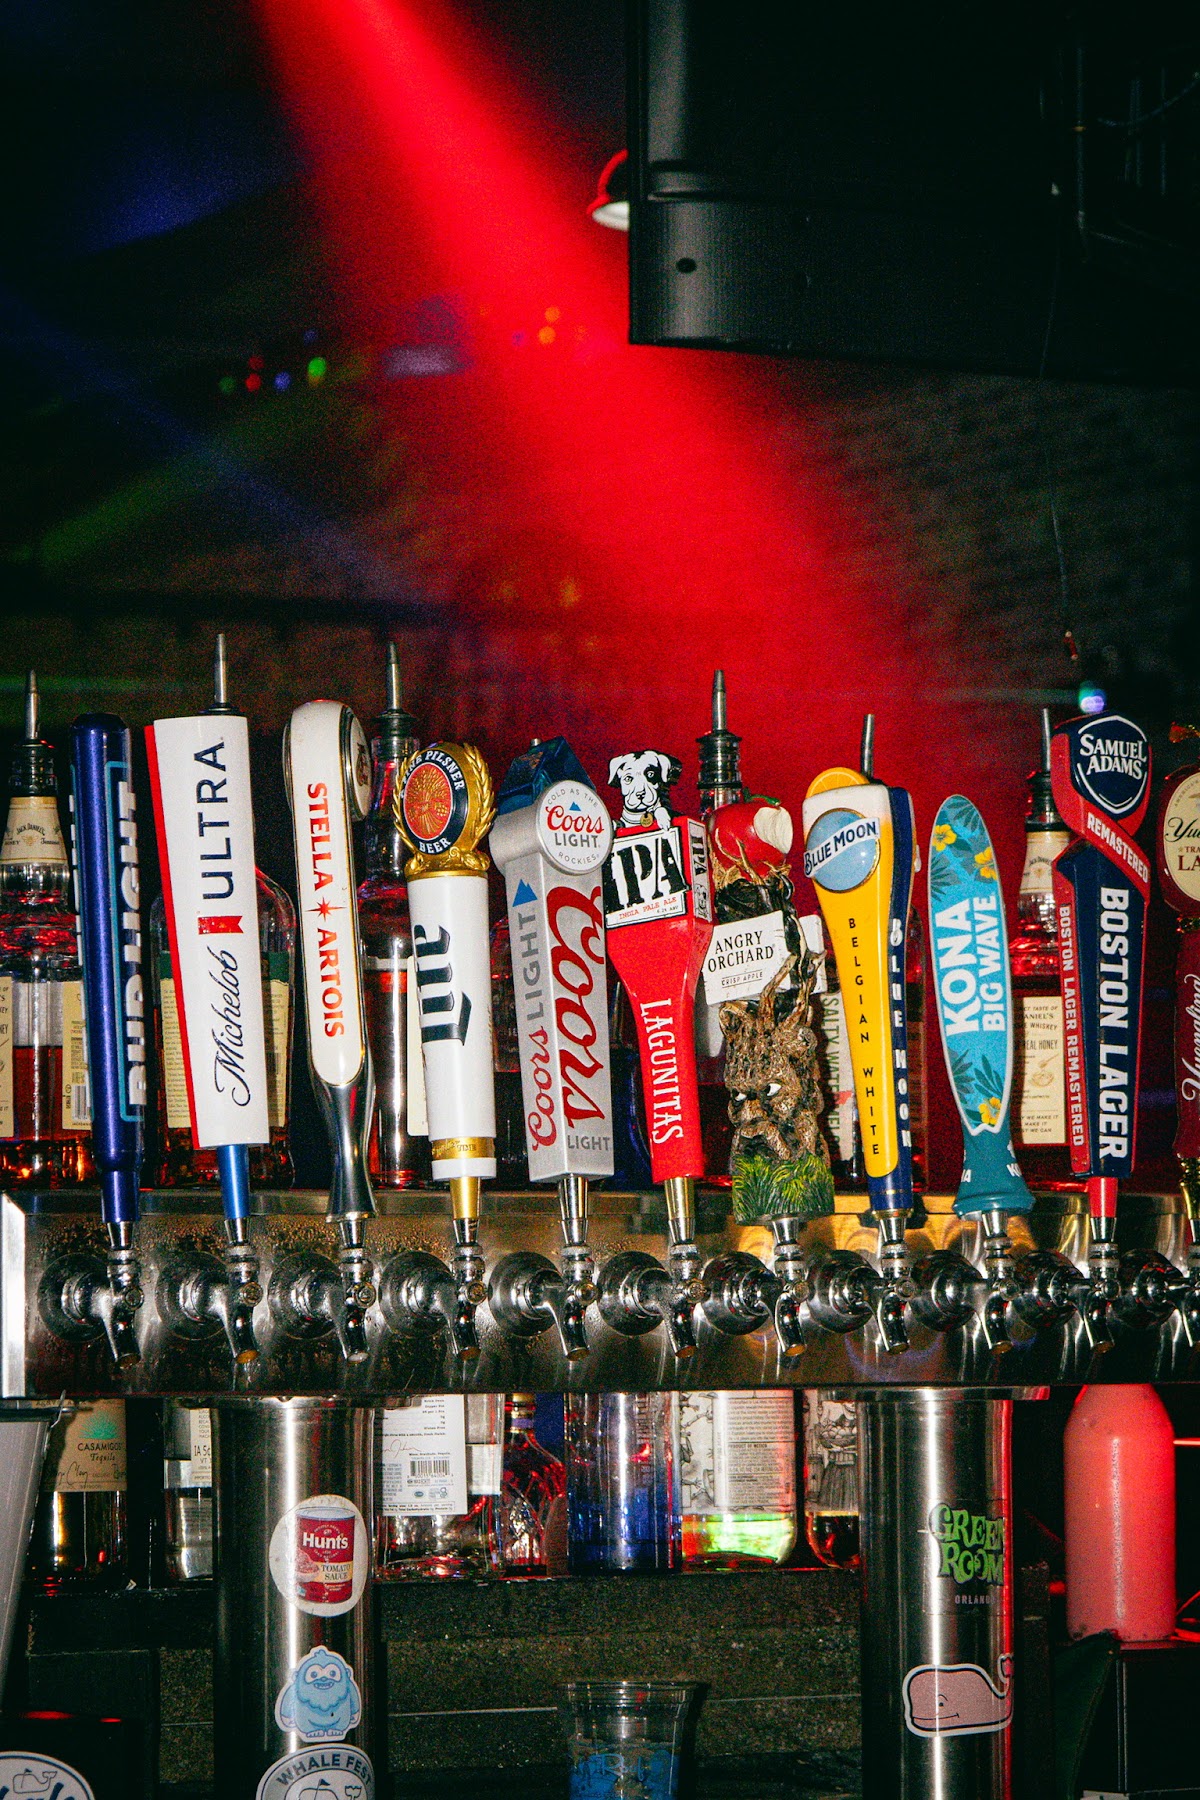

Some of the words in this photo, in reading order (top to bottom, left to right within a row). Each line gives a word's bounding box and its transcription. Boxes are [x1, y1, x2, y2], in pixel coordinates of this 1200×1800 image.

[1080, 733, 1146, 762] SAMUEL
[1086, 755, 1142, 780] ADAMS
[425, 750, 465, 790] PILSNER
[547, 788, 566, 805] COLD
[584, 793, 599, 807] THE
[194, 741, 234, 900] ULTRA
[307, 782, 334, 892] STELLA
[545, 805, 605, 834] Coors
[554, 832, 599, 848] LIGHT
[419, 838, 451, 853] BEER
[558, 851, 597, 865] ROCKIES
[690, 834, 707, 876] IPA
[804, 842, 832, 876] BLUE
[833, 821, 878, 853] MOON
[1087, 812, 1149, 883] REMASTERED
[618, 909, 640, 920] INDIA
[642, 903, 660, 913] PALE
[663, 896, 677, 905] ALE
[715, 930, 763, 954] ANGRY
[973, 894, 1001, 977] WAVE
[1060, 906, 1075, 971] BOSTON
[518, 912, 545, 1021] LIGHT
[707, 945, 774, 973] ORCHARD
[721, 977, 740, 986] CRISP
[743, 972, 763, 982] APPLE
[935, 899, 982, 1036] KONA
[1100, 887, 1129, 1029] BOSTON
[317, 927, 345, 1038] ARTOIS
[1064, 977, 1078, 1030] LAGER
[207, 945, 251, 1106] Michelob
[546, 886, 605, 1128] Coors
[979, 982, 1006, 1032] BIG
[1030, 1022, 1058, 1031] WHISKEY
[848, 918, 869, 1043] BELGIAN
[862, 1067, 880, 1155] WHITE
[1039, 1040, 1058, 1050] HONEY
[527, 1025, 557, 1151] Coors
[640, 998, 684, 1144] LAGUNITAS
[1067, 1035, 1084, 1146] REMASTERED
[1098, 1043, 1129, 1160] LAGER
[567, 1135, 611, 1150] LIGHT
[78, 1442, 122, 1451] CASAMIGOS
[303, 1532, 349, 1549] Hunt's
[321, 1564, 350, 1572] TOMATO
[325, 1572, 348, 1580] SAUCE
[937, 1541, 1005, 1584] ROOM
[276, 1754, 341, 1786] WHALE
[346, 1756, 372, 1786] FEST
